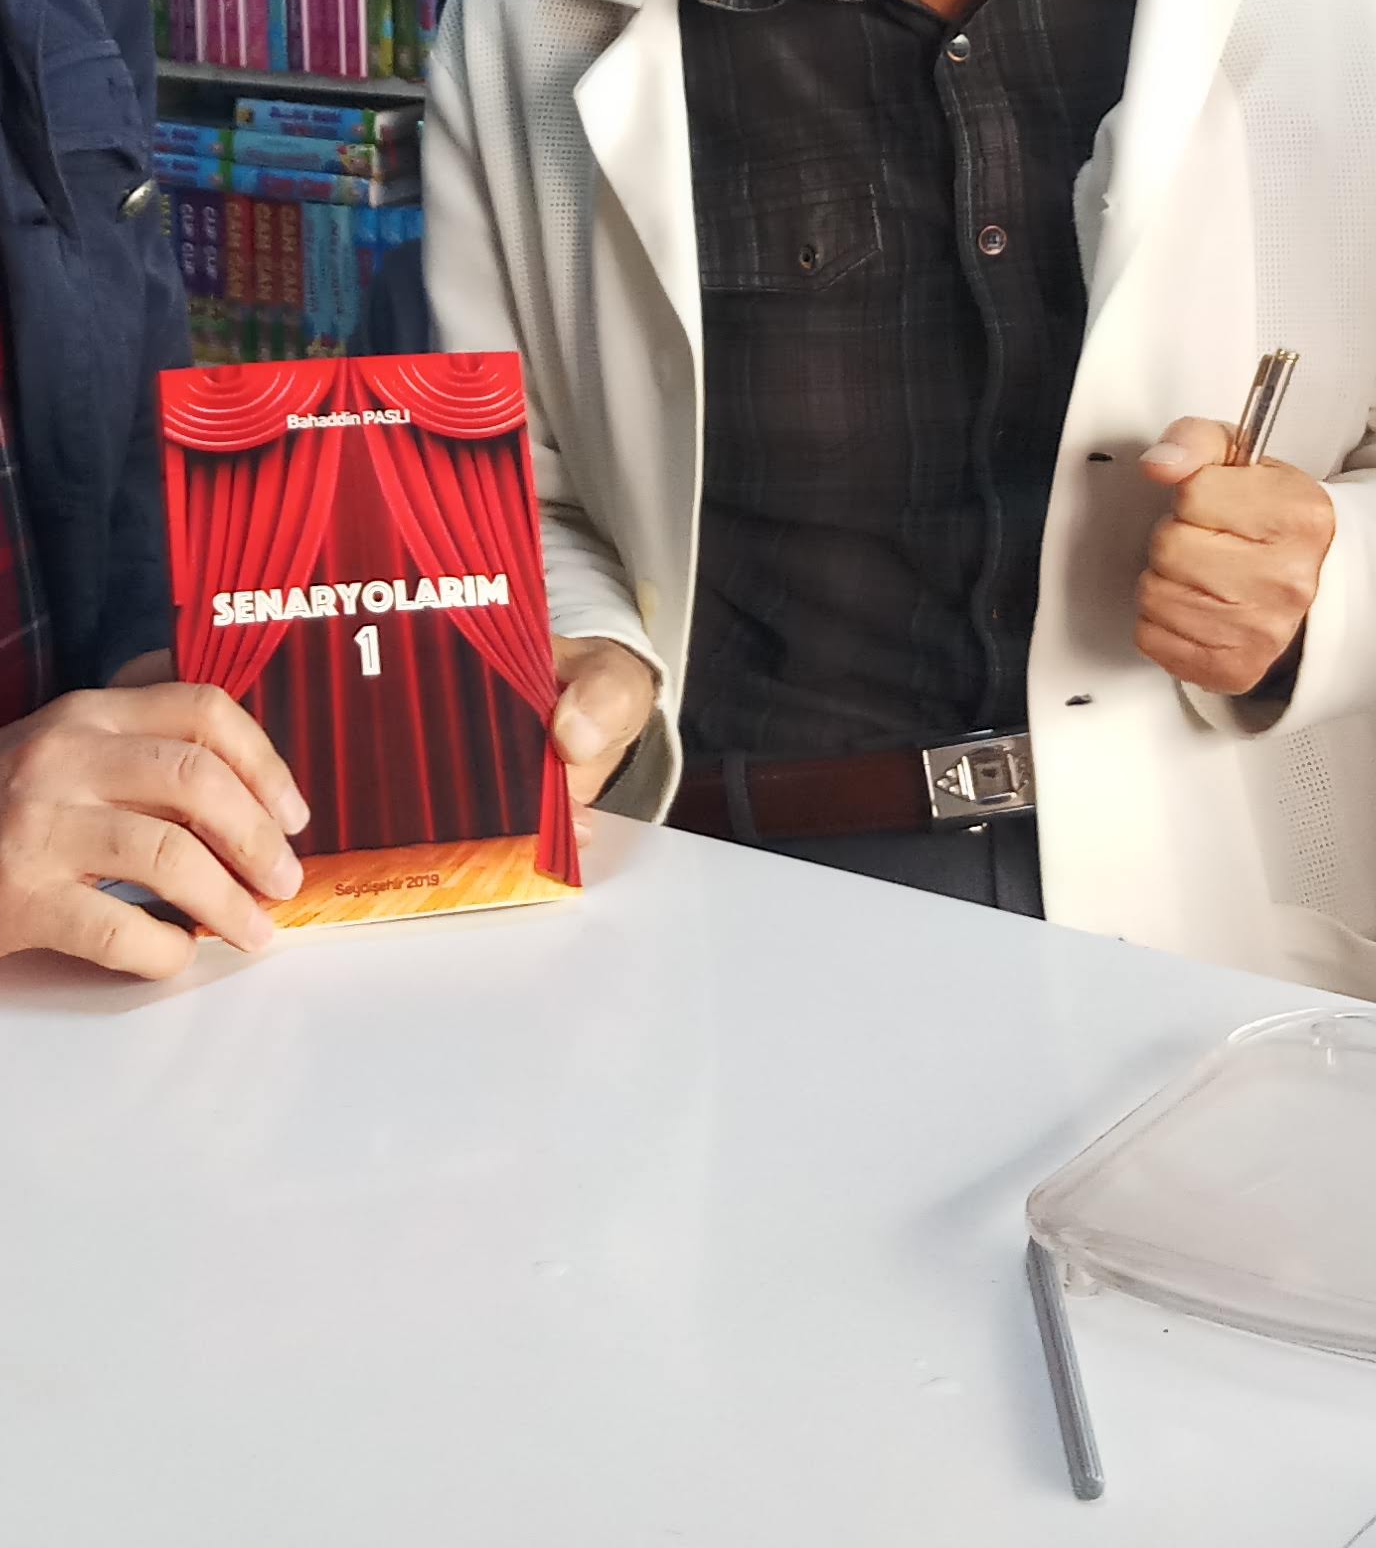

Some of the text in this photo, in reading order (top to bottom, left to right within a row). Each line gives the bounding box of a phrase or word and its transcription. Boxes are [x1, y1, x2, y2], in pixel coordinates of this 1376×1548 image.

[286, 408, 411, 430] Bahaddin PASLI
[212, 573, 510, 627] SENARYOLARIM
[354, 624, 382, 677] 1
[334, 873, 440, 898] Seydişehir 2019
